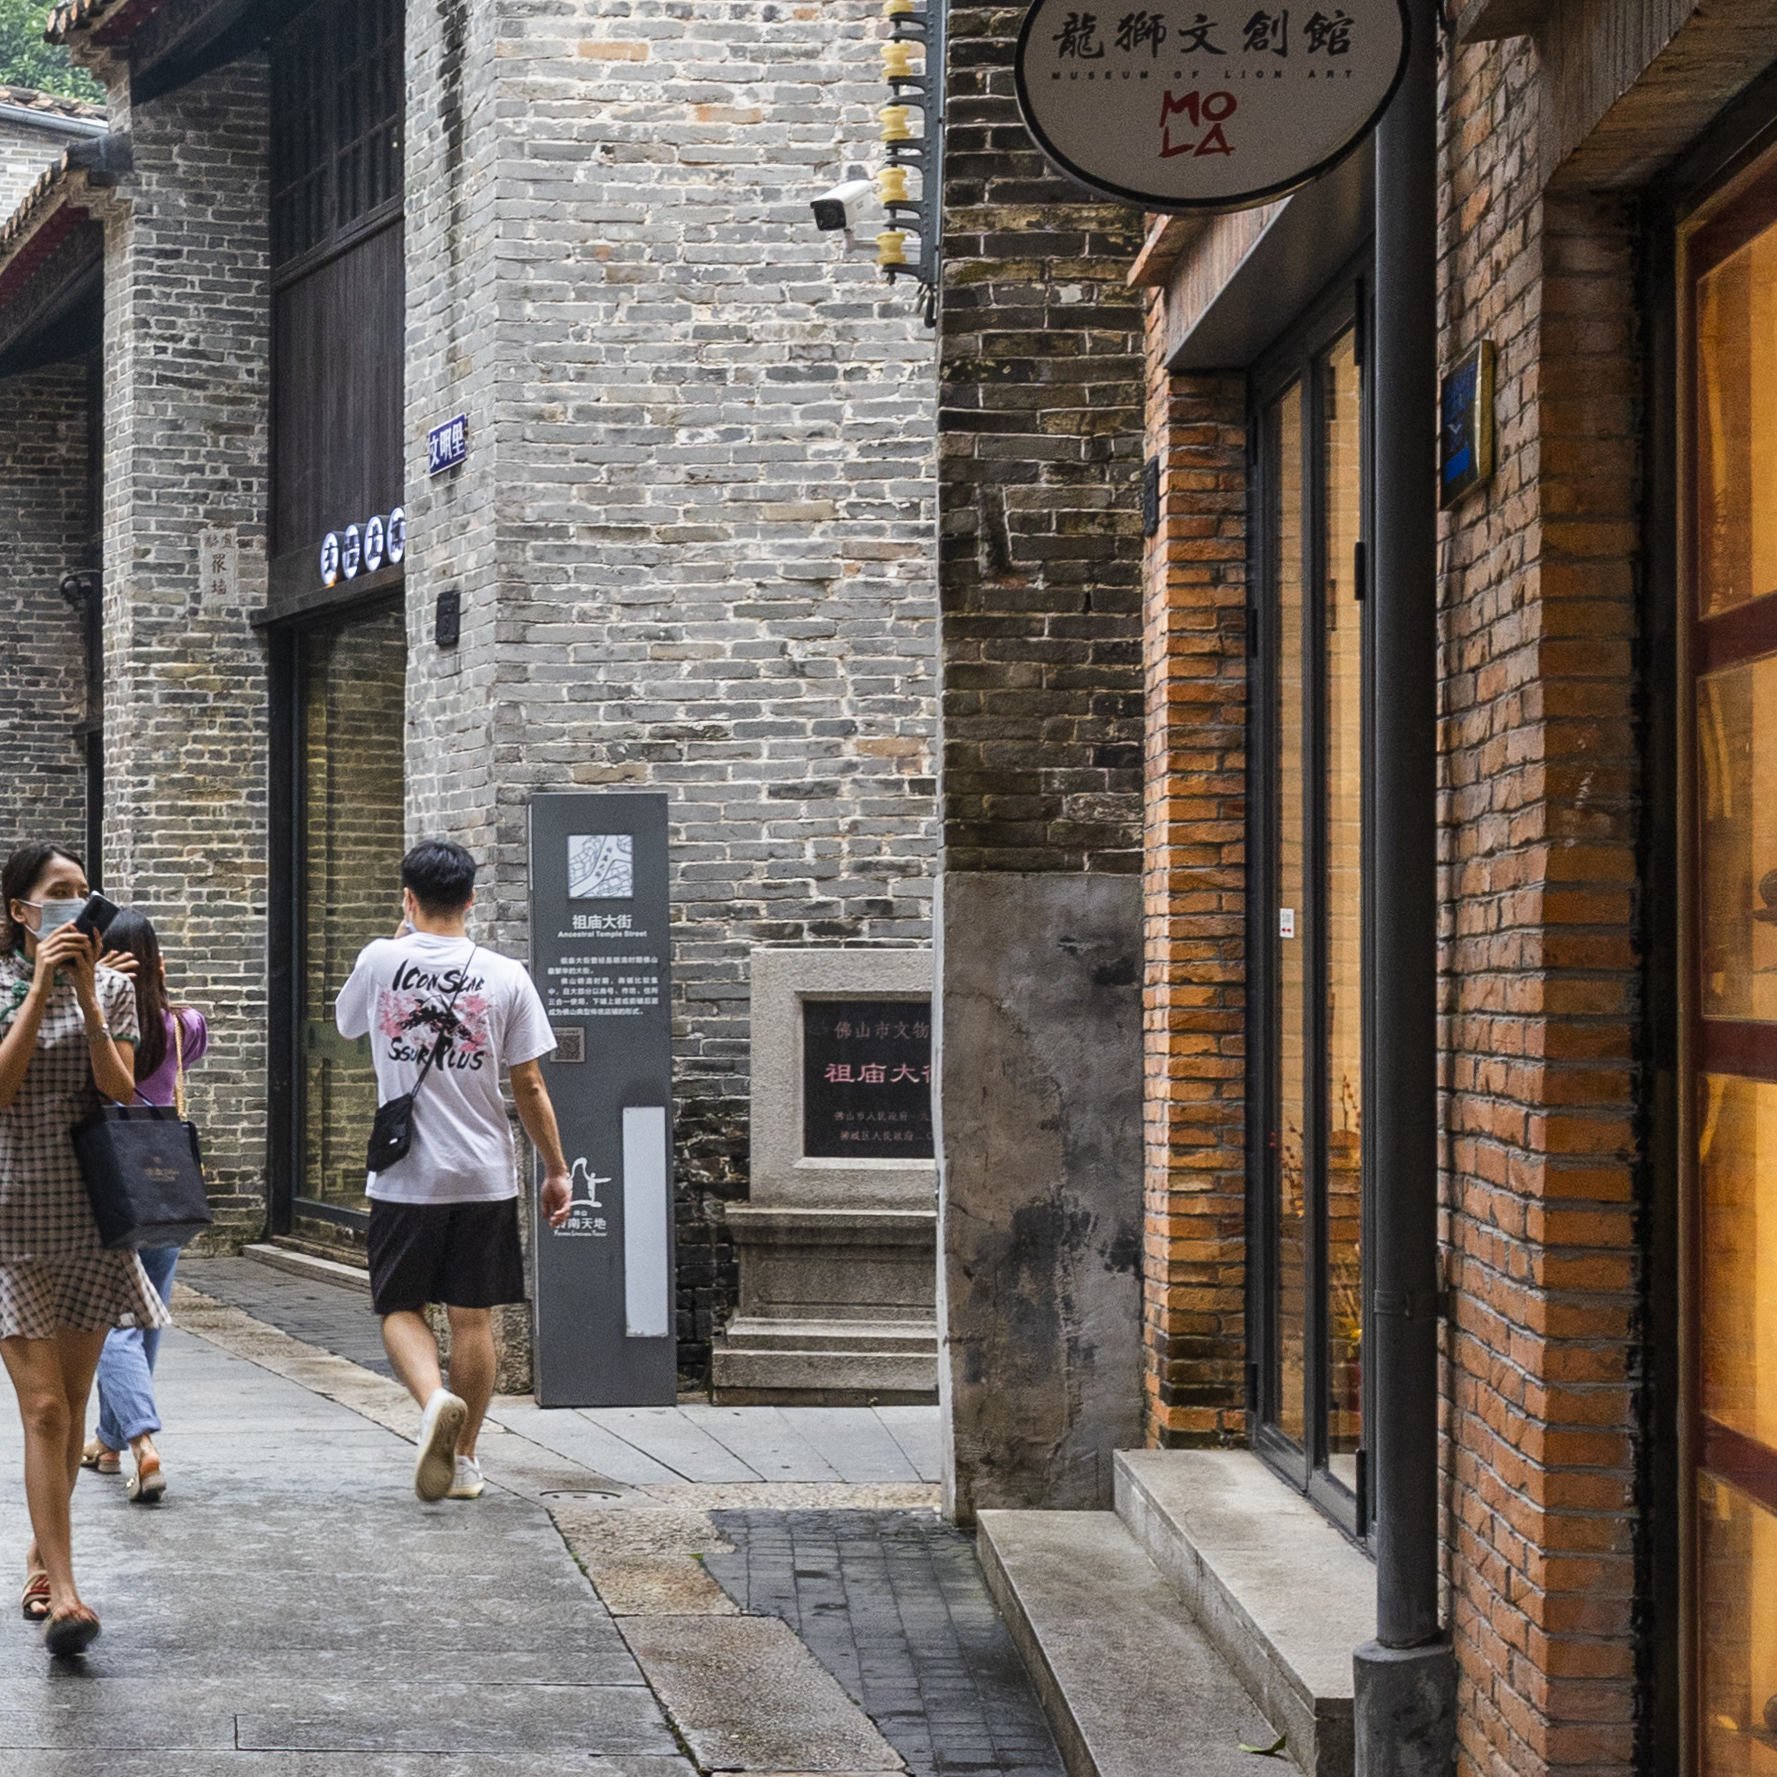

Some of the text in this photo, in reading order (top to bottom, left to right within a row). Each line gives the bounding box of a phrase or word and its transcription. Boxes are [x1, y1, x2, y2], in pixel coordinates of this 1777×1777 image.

[1051, 9, 1355, 60] 龍獅文創館
[1051, 69, 1354, 80] MUSEUM OF LION ART
[1159, 90, 1238, 128] MO
[1158, 123, 1236, 158] LA
[429, 421, 466, 470] 文明里
[557, 930, 648, 938] Ancestral Temple Street
[572, 914, 632, 930] 祖庙大街
